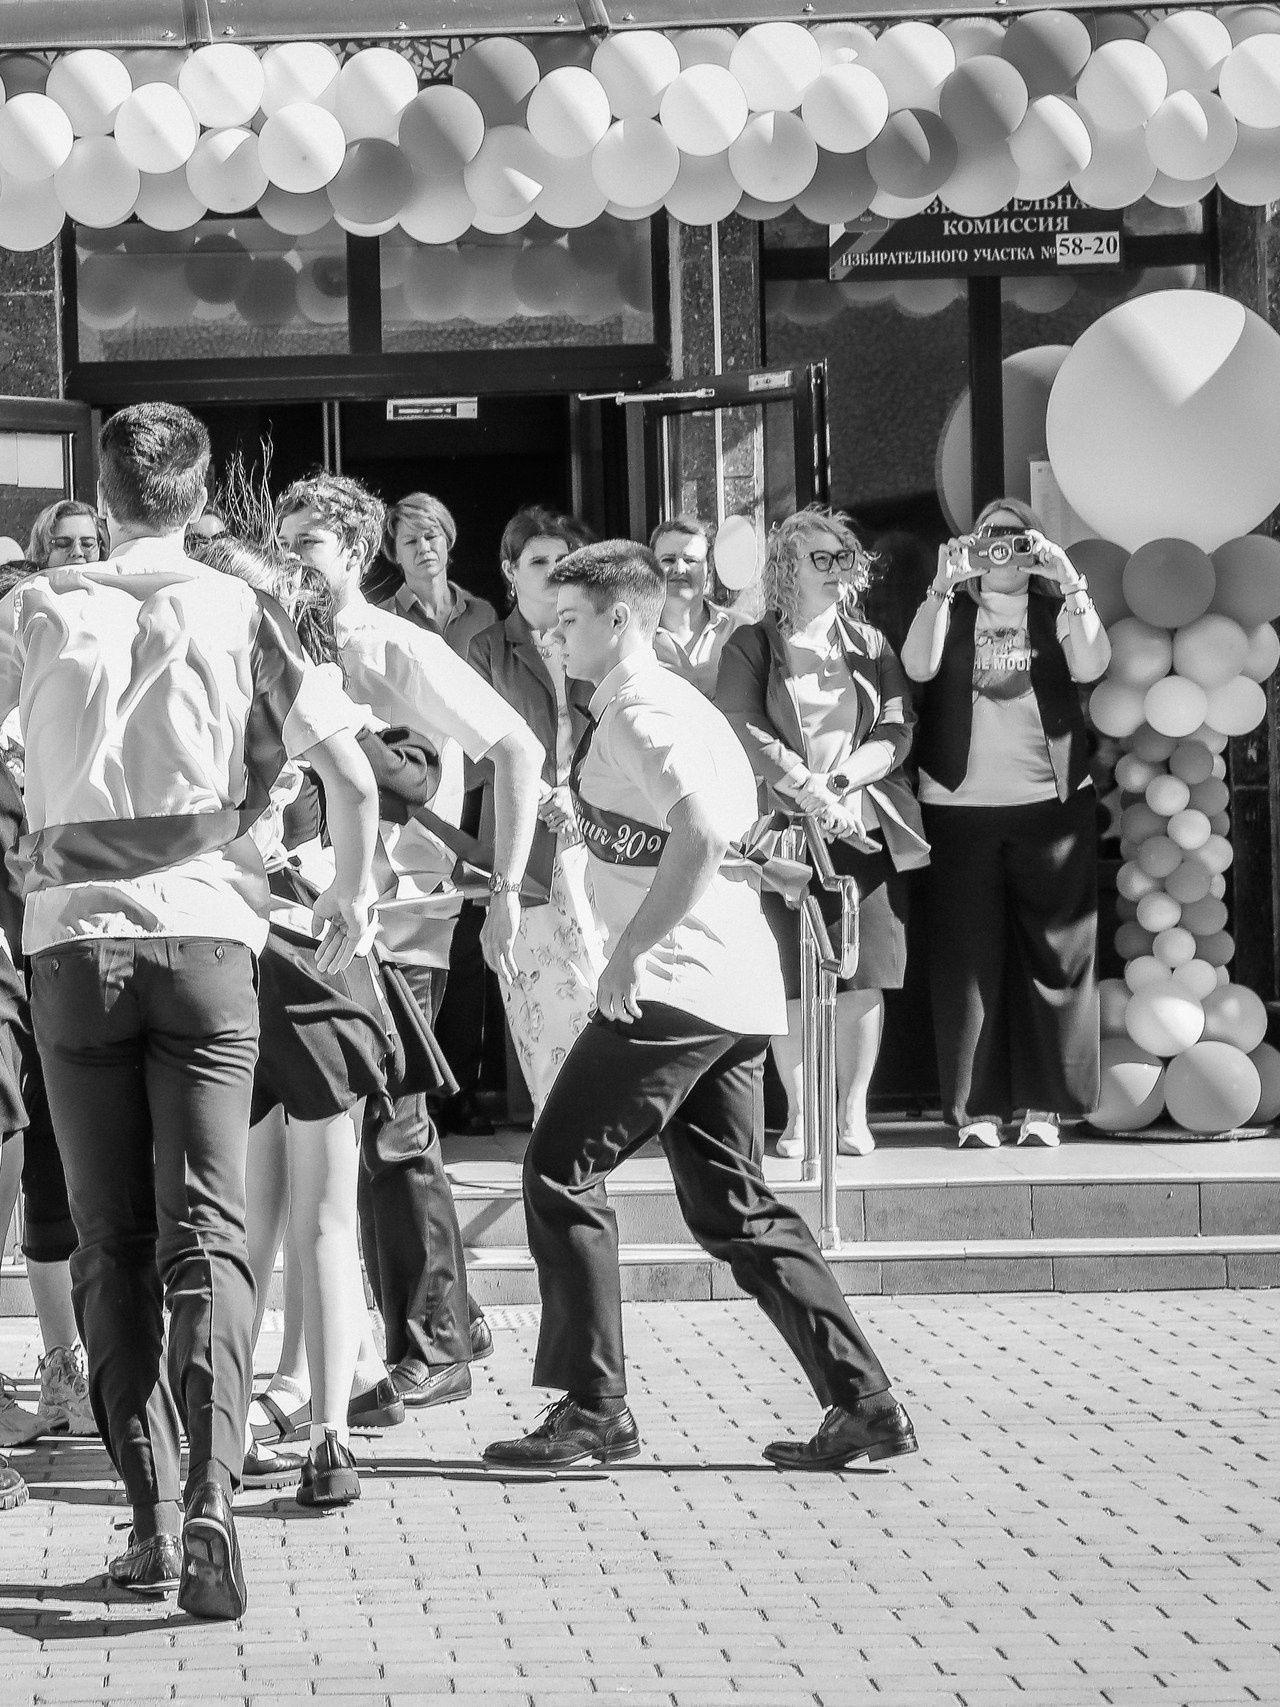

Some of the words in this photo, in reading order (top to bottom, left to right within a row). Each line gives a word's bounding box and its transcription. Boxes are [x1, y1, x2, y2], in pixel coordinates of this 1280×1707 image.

[943, 215, 1070, 236] КОМИССИЯ
[841, 248, 968, 268] ИЗБИРАТЕЛЬНОГО
[973, 246, 1036, 263] УЧАСТКА
[1058, 234, 1119, 258] 58-20
